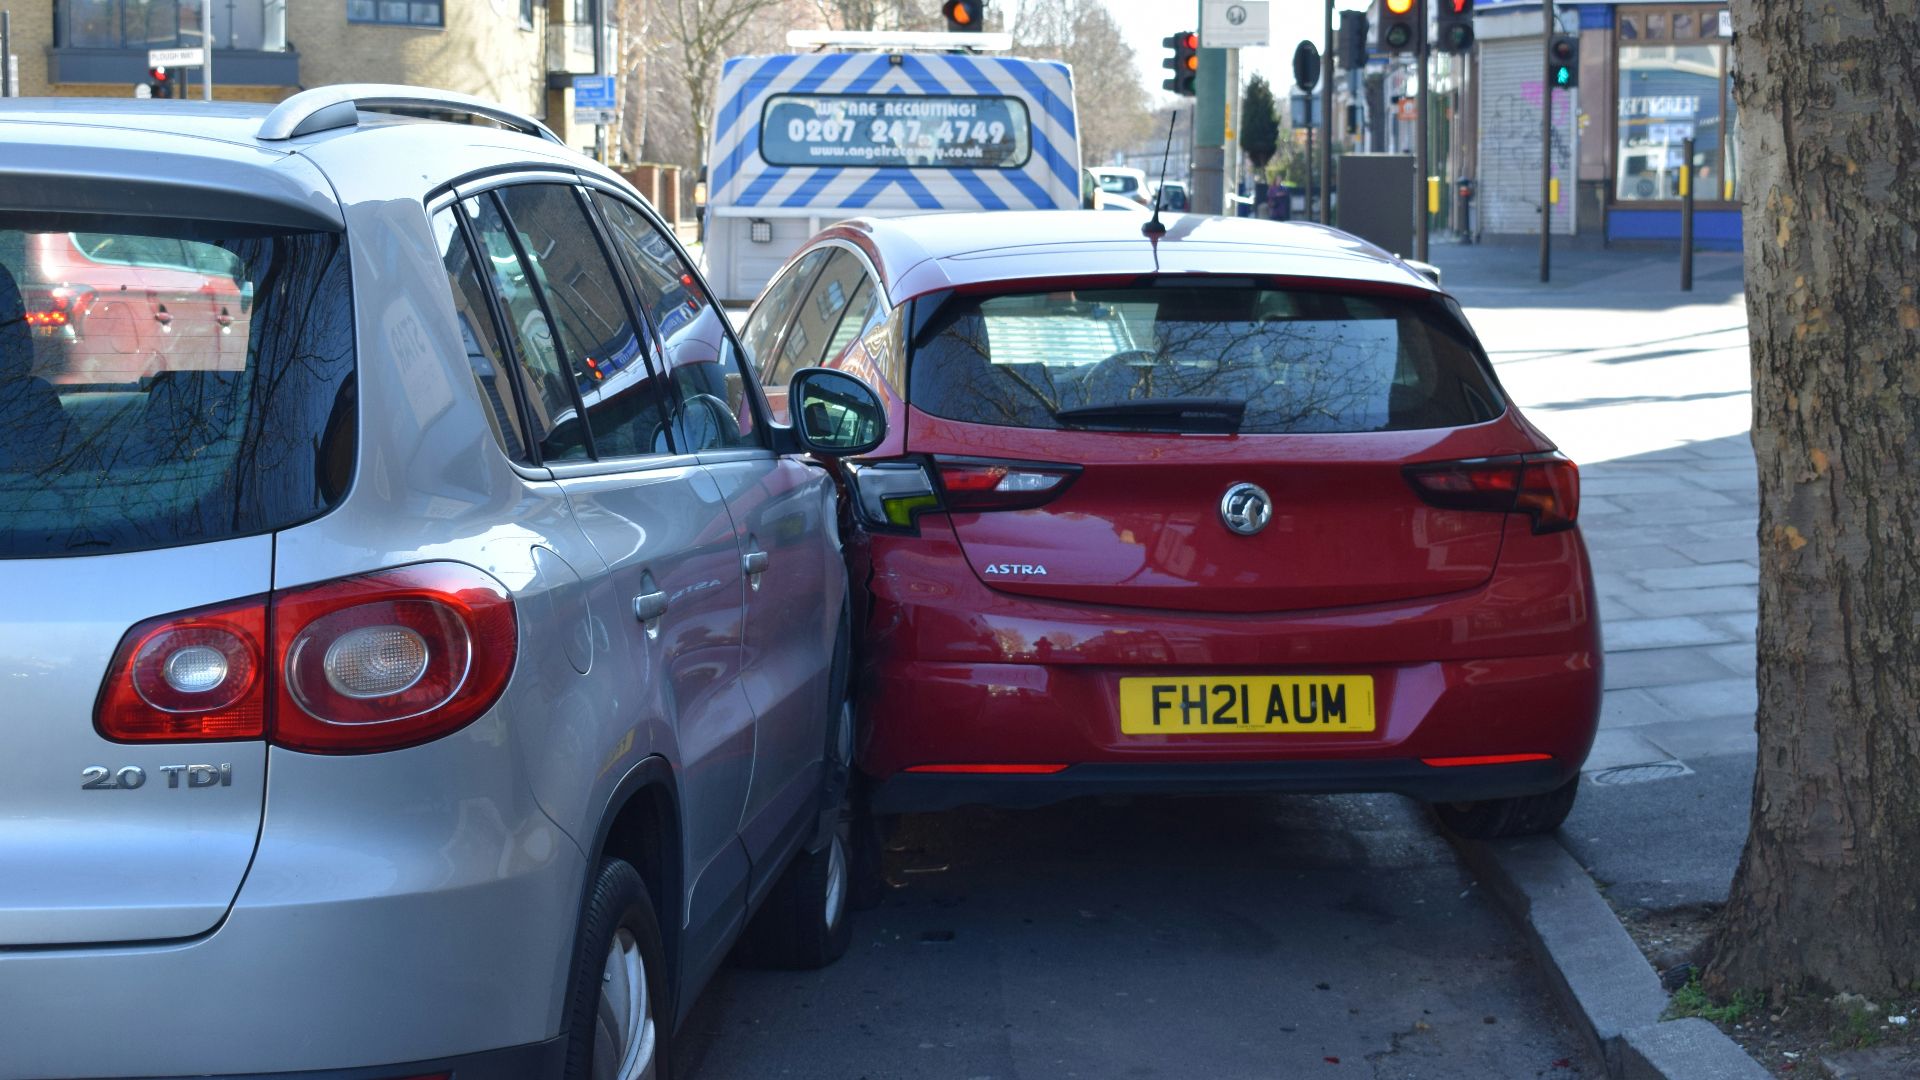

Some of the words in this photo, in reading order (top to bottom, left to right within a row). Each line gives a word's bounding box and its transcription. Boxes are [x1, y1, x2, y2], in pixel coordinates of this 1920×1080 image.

[816, 102, 842, 115] WE
[848, 102, 877, 116] ARE
[884, 102, 977, 118] RECRUITING!
[788, 118, 856, 142] 0207
[871, 119, 921, 143] 247
[937, 121, 1005, 144] 4749
[985, 564, 1047, 575] ASTRA
[1152, 684, 1249, 725] FH21
[1265, 683, 1347, 724] AUM
[82, 765, 147, 790] 2.0
[160, 763, 231, 789] TDI
